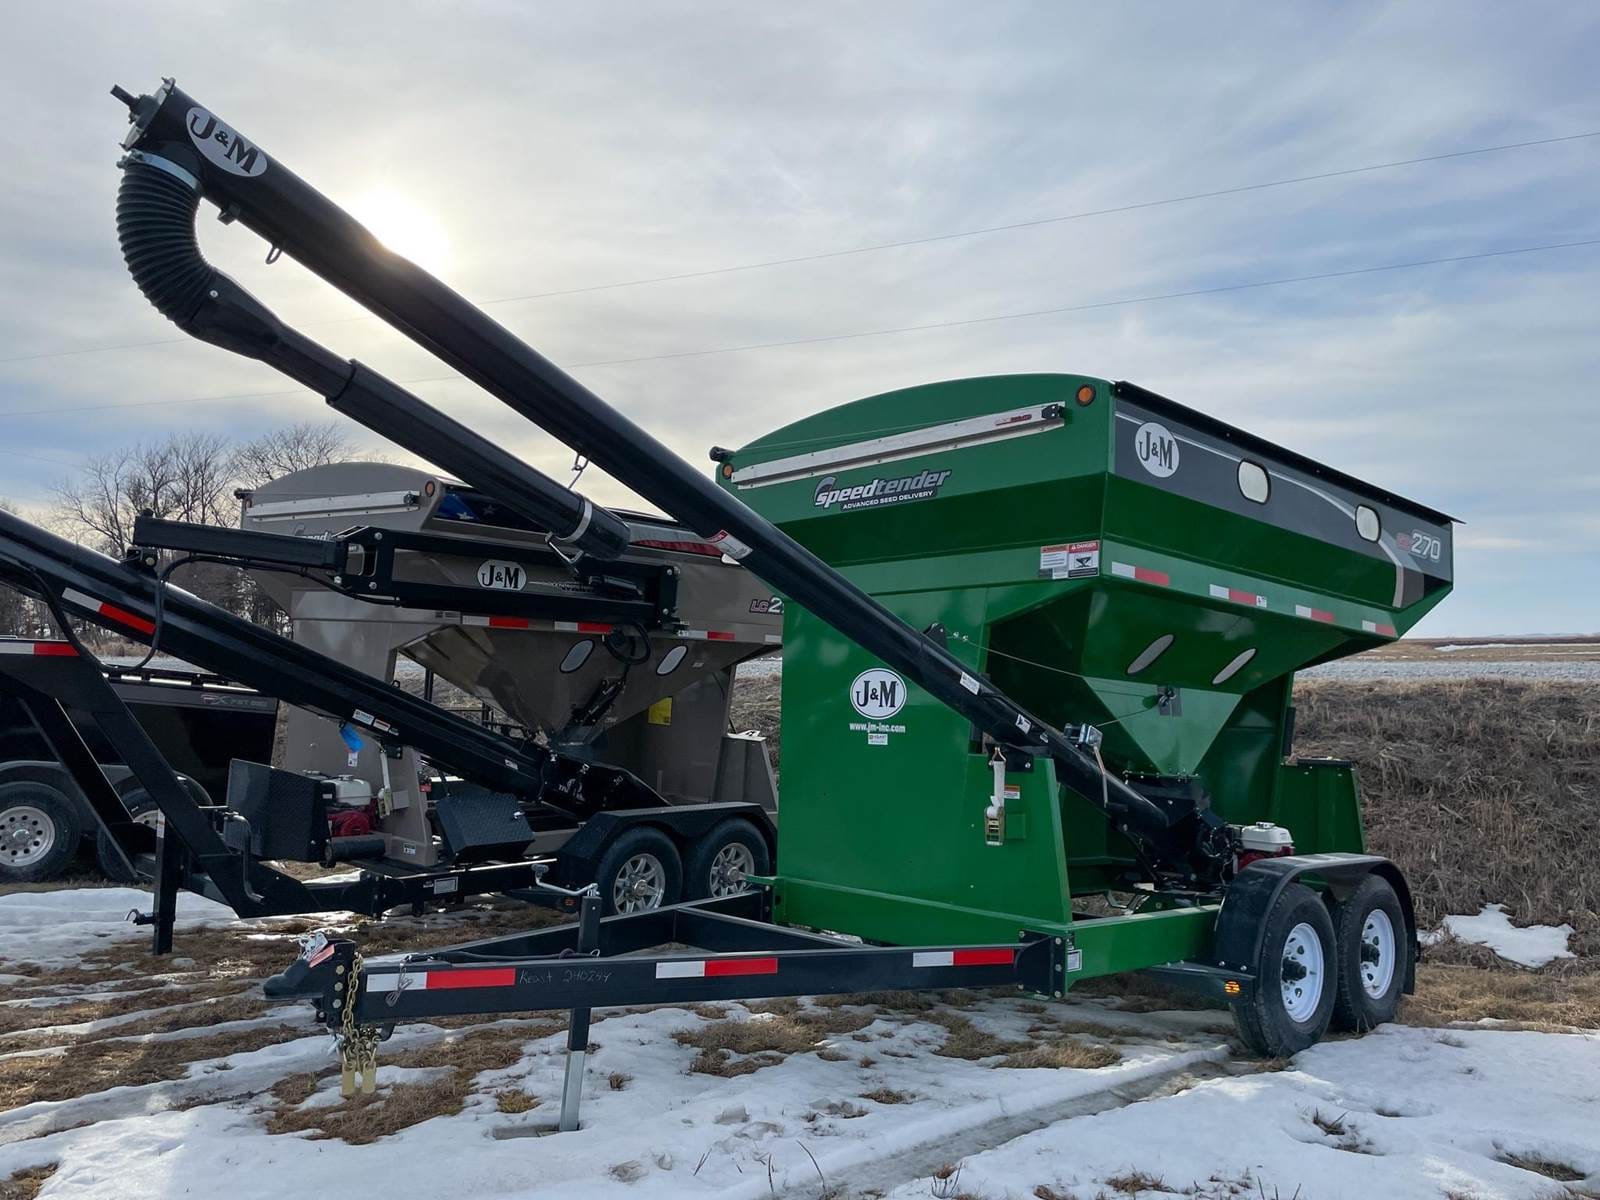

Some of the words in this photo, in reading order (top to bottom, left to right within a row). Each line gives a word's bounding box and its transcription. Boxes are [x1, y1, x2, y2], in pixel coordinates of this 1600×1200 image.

[190, 113, 260, 174] J&M
[1139, 430, 1173, 470] J&M
[842, 498, 879, 510] ADVANCED
[879, 495, 897, 504] SEED
[898, 490, 934, 501] DELIVERY
[481, 564, 520, 589] J&M
[855, 680, 899, 708] J&M
